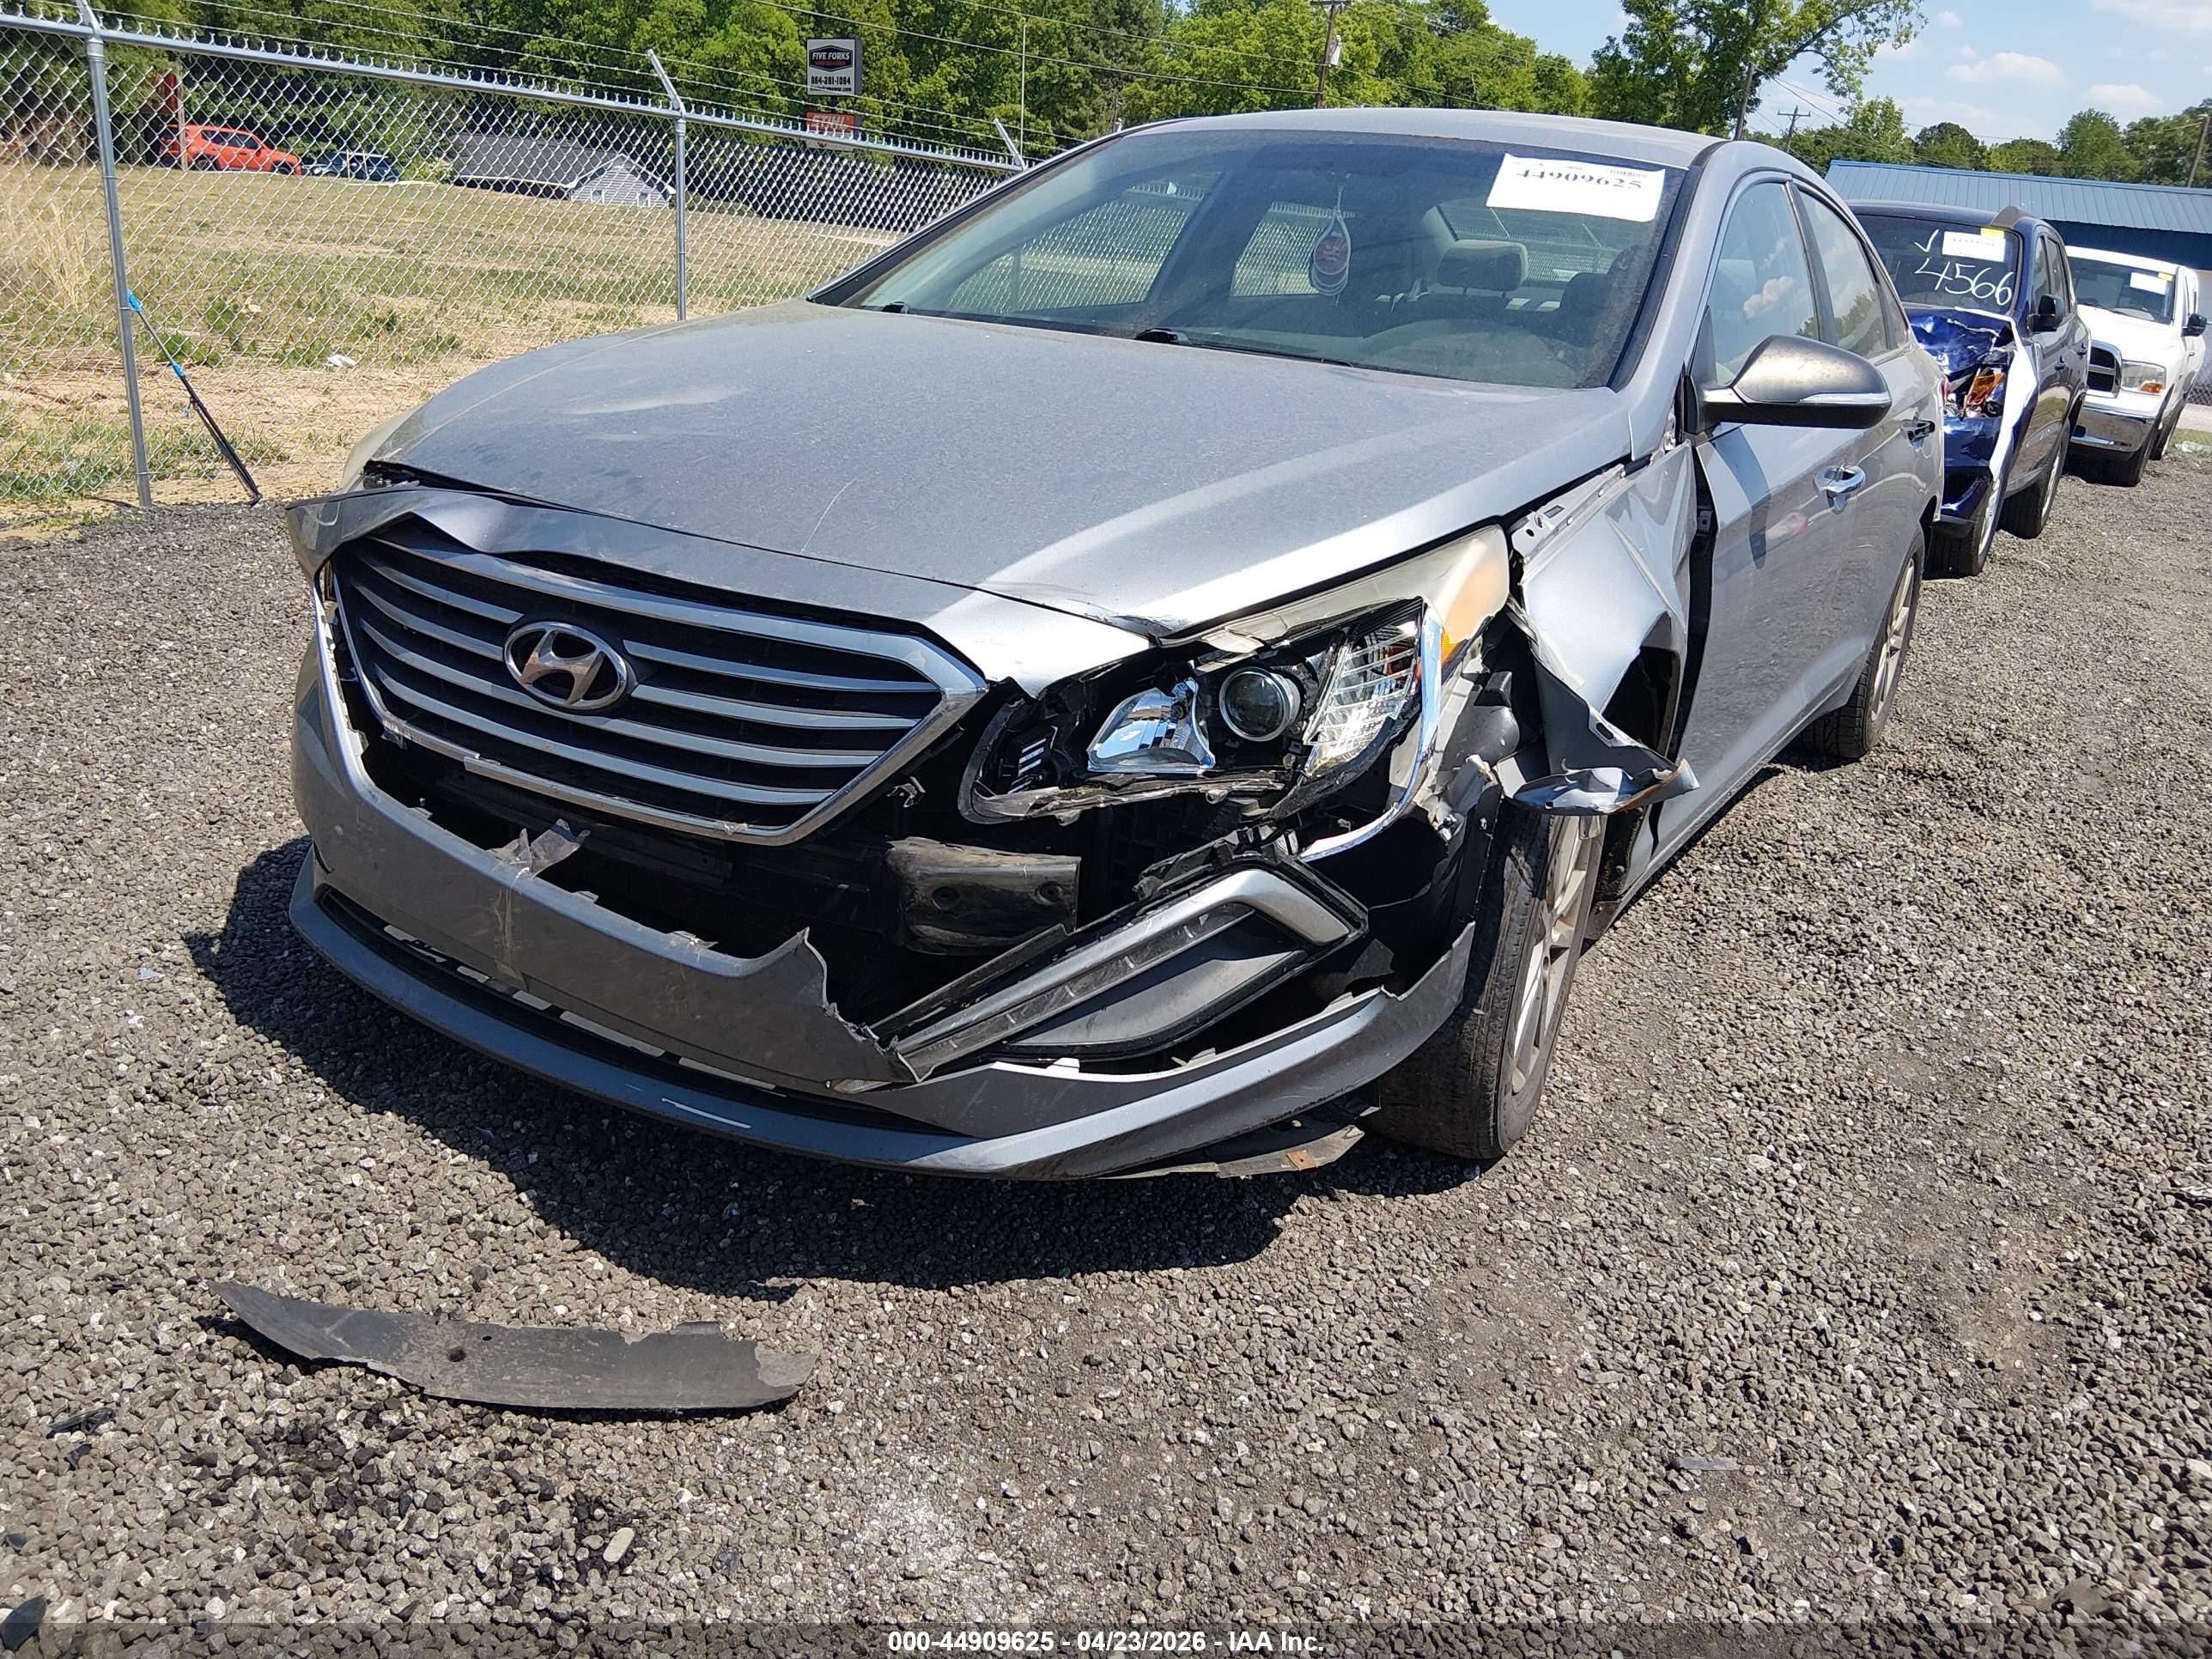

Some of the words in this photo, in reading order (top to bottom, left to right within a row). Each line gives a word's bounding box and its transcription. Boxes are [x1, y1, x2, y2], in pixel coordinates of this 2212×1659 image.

[811, 52, 827, 60] FIVE
[828, 52, 850, 60] FORKS
[811, 114, 847, 131] STIHL
[1516, 168, 1643, 190] 44909625
[1912, 257, 2014, 307] 4566
